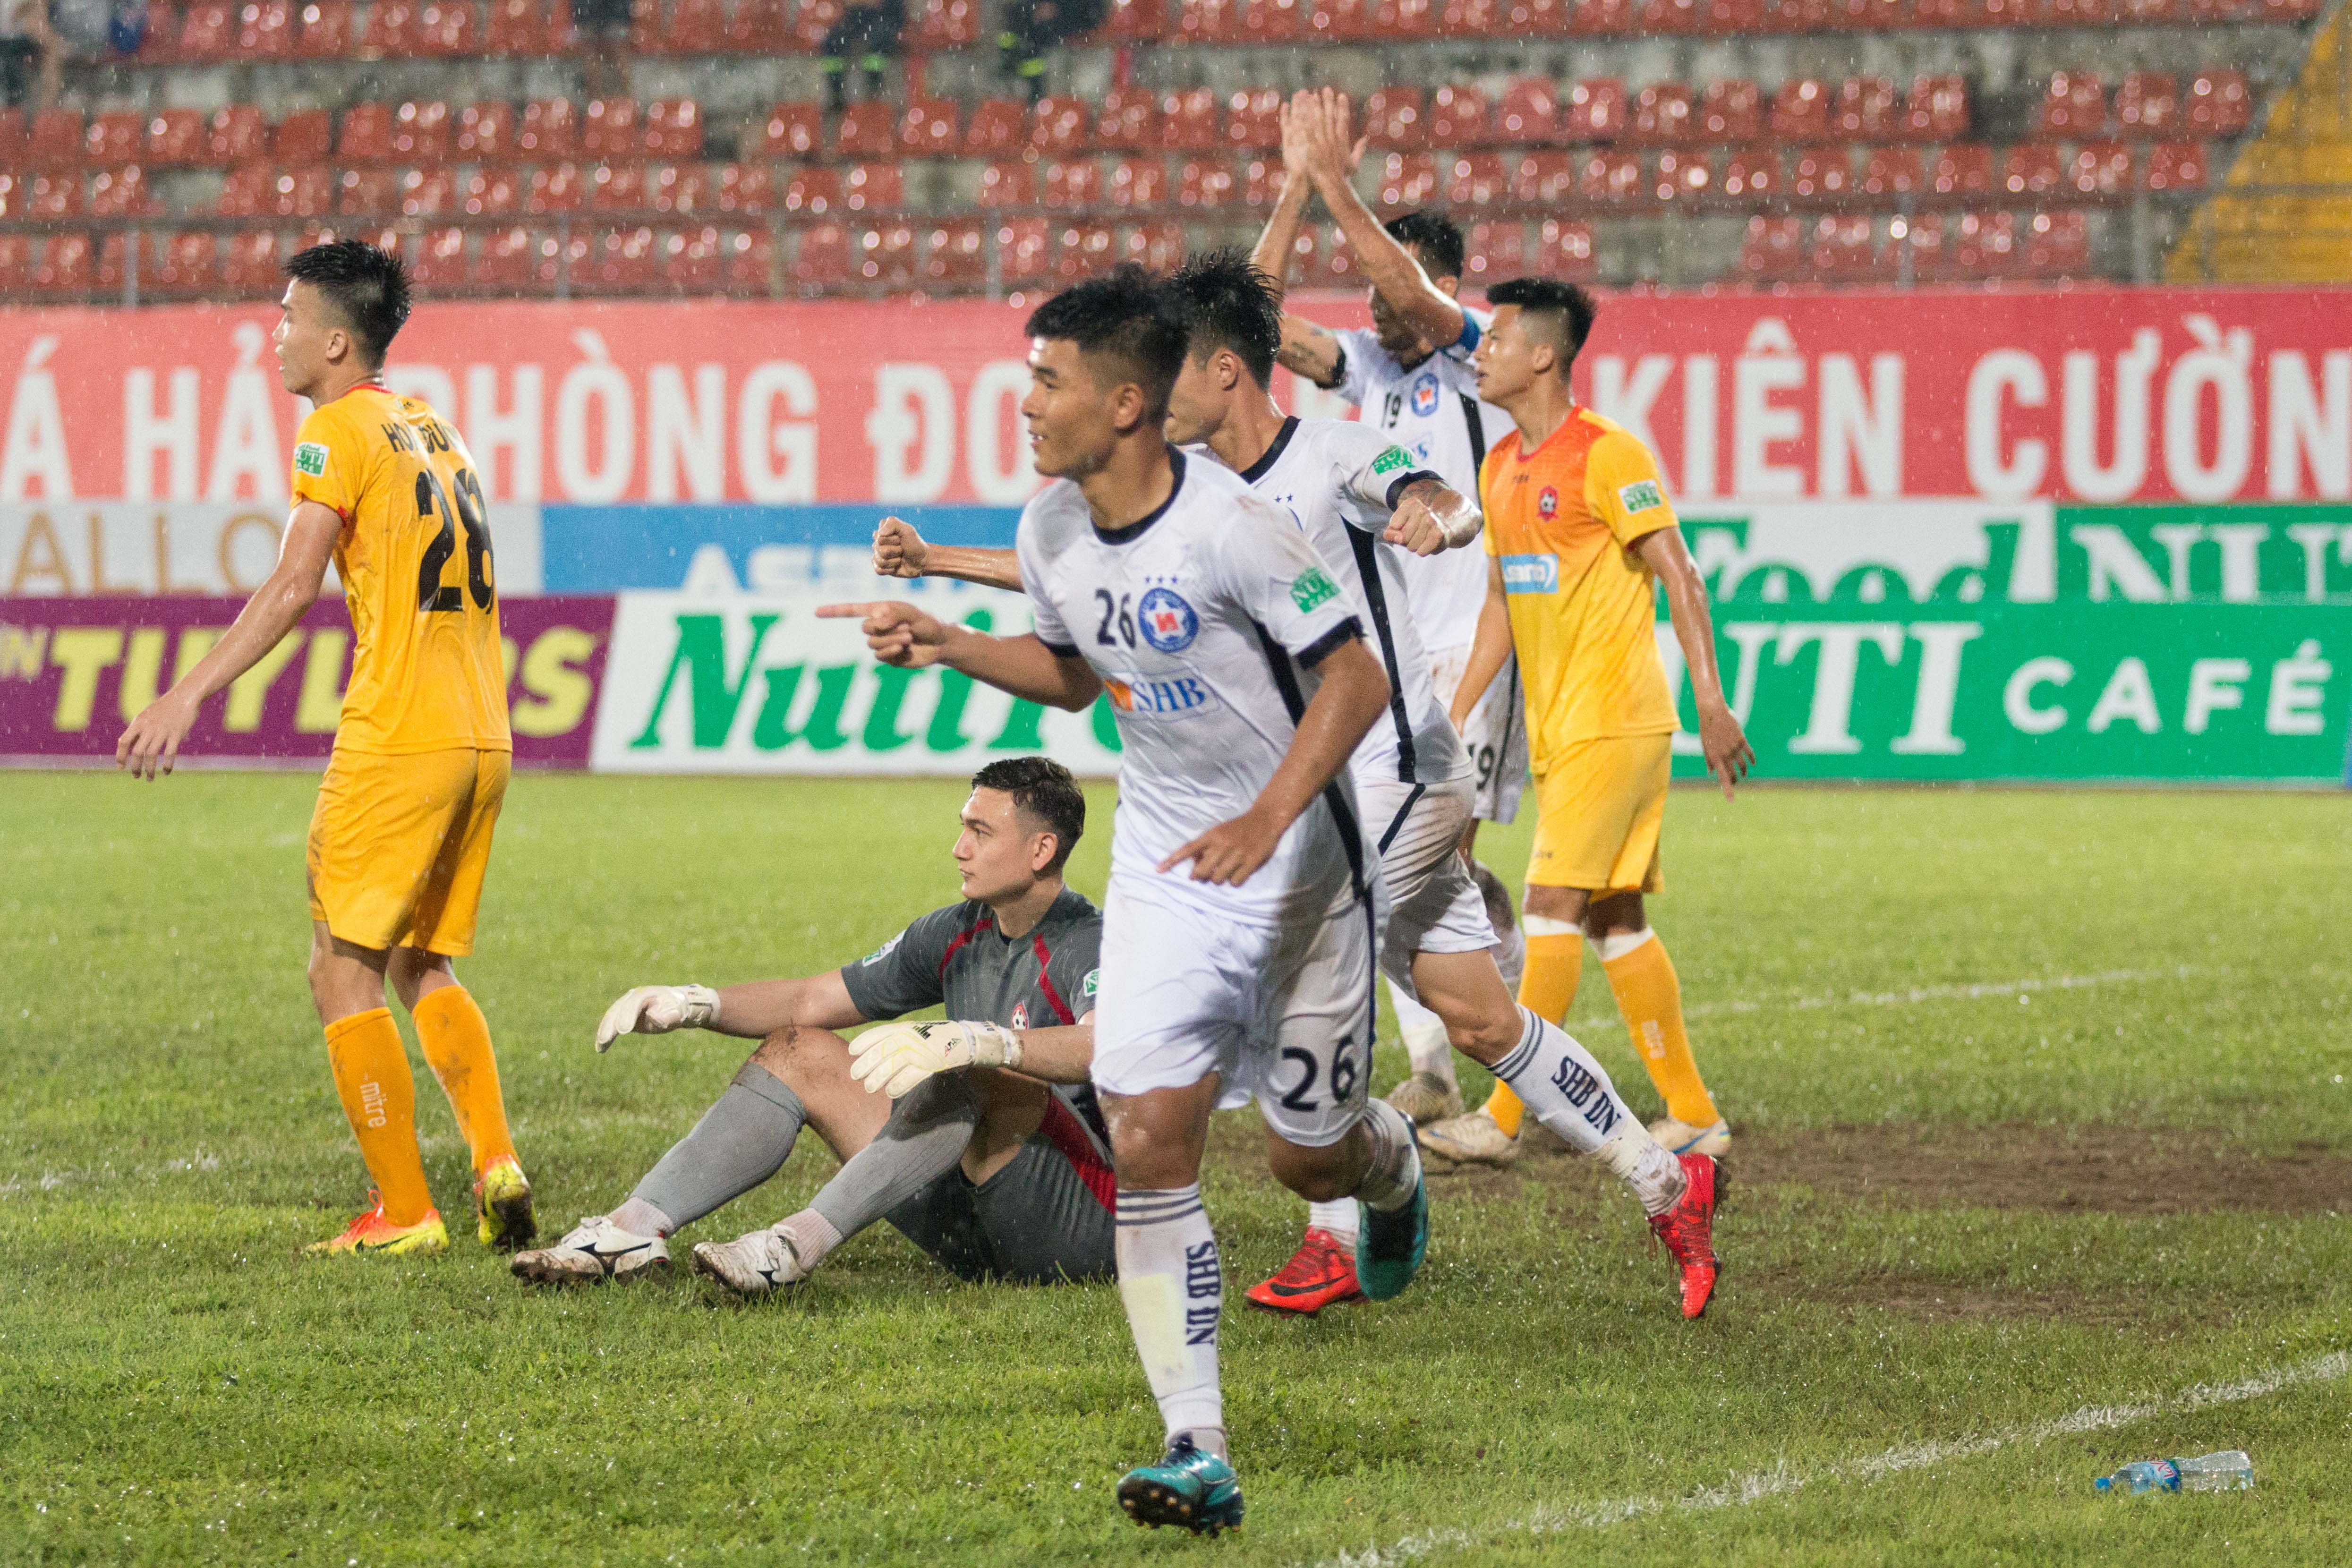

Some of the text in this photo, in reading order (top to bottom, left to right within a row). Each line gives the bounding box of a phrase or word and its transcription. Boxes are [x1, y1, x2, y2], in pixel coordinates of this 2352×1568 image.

[124, 321, 317, 502] HẢ
[1592, 316, 1906, 502] KIÊN
[416, 469, 494, 614] 28
[1094, 588, 1136, 649] 26
[1132, 678, 1207, 712] SHB
[2003, 638, 2334, 737] CAFÉ
[1466, 743, 1495, 791] 9
[360, 1081, 388, 1128] mitre
[1281, 1035, 1357, 1113] 26
[1551, 1055, 1623, 1136] SHB DN
[1185, 1239, 1221, 1347] SHB DN
